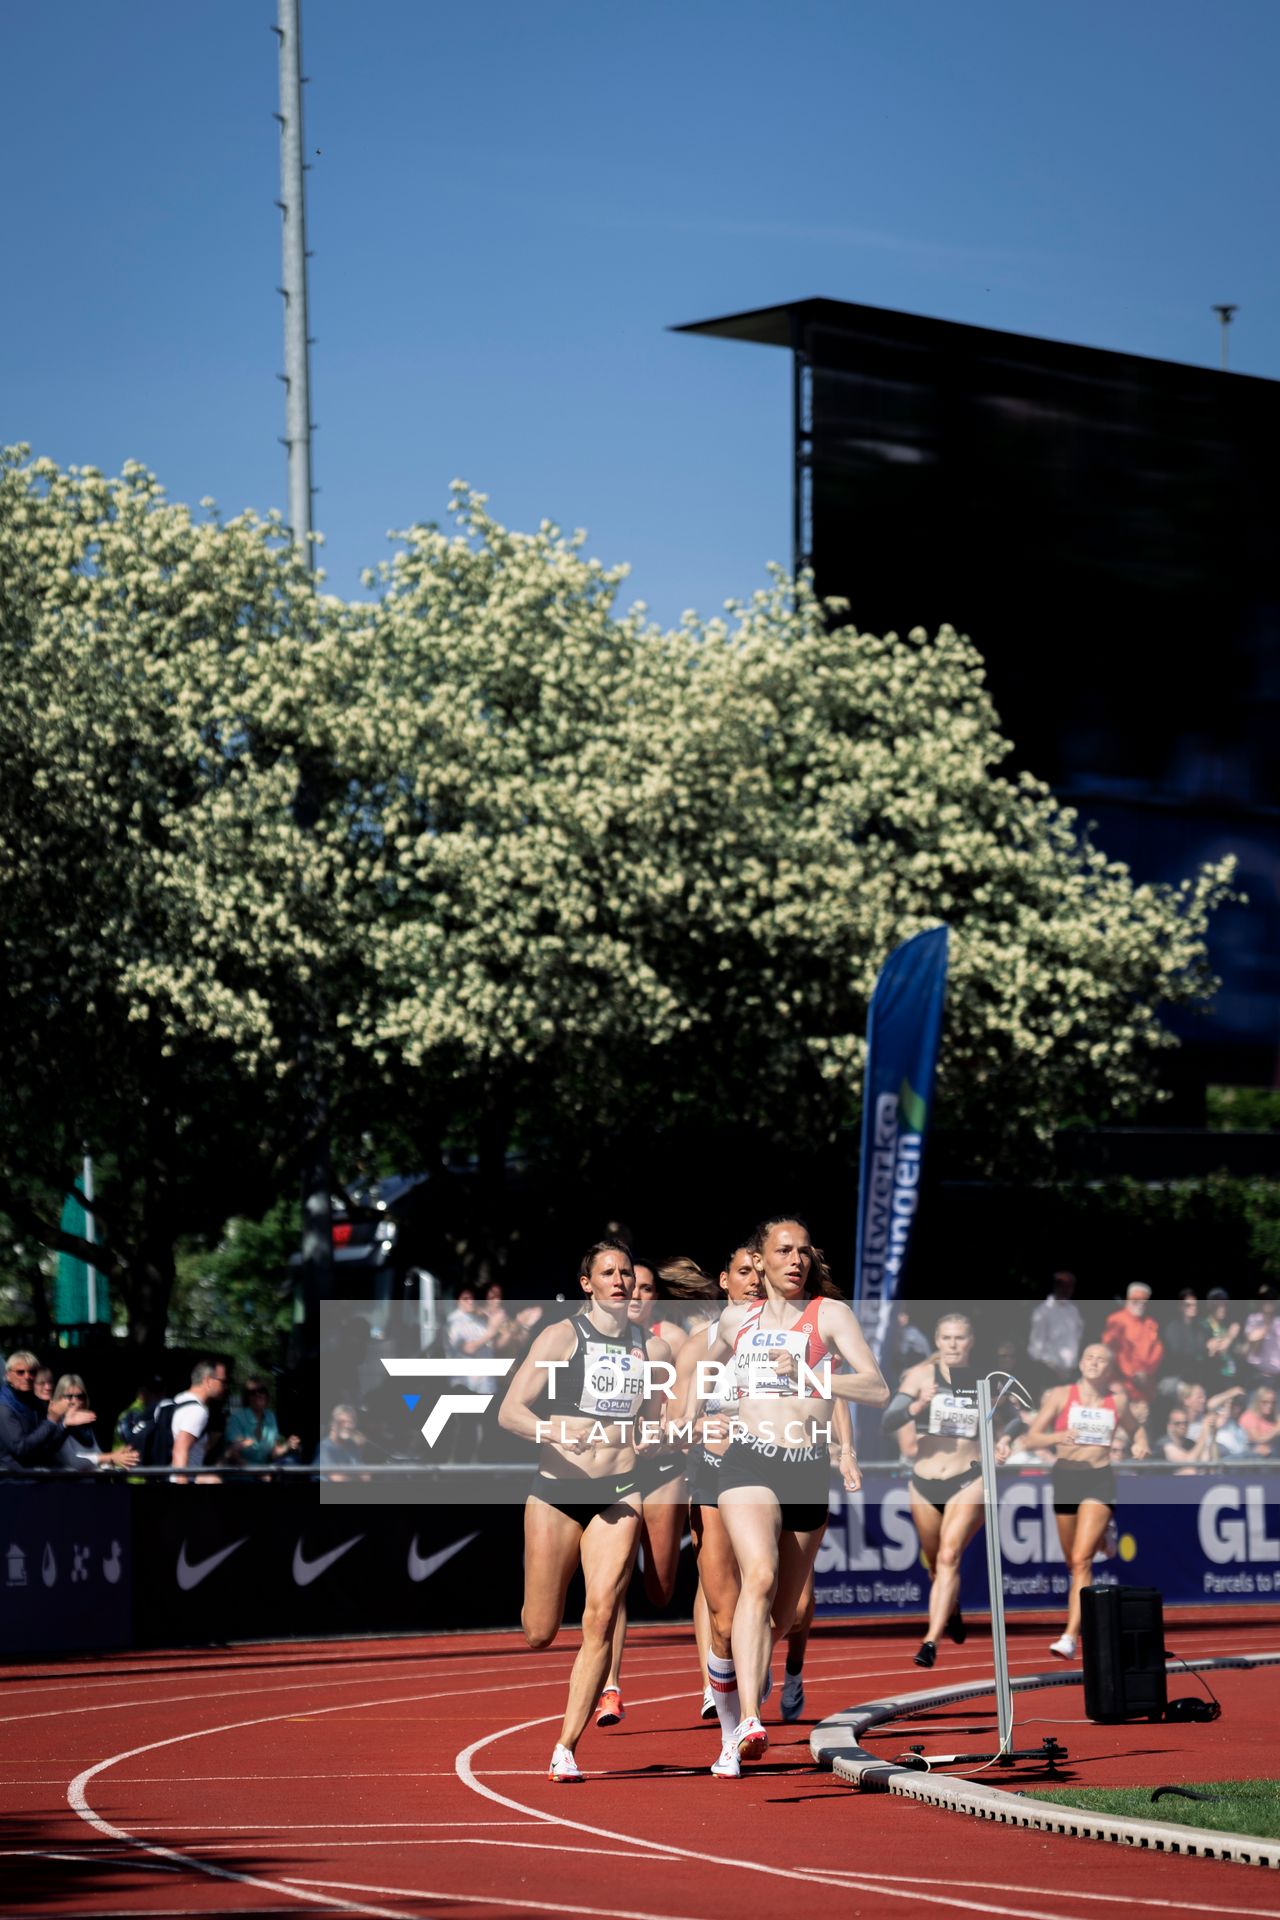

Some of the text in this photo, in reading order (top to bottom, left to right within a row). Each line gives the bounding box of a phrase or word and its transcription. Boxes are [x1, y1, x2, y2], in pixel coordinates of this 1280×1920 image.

[752, 1333, 787, 1347] GLS
[592, 1374, 644, 1395] SCHFER
[611, 1401, 631, 1409] PLAN
[783, 1445, 824, 1463] NIKE
[1003, 1573, 1049, 1595] Parcels
[1052, 1573, 1068, 1594] to
[1203, 1571, 1255, 1593] Parcels
[1256, 1573, 1273, 1592] to
[814, 1581, 921, 1608] arcels to People
